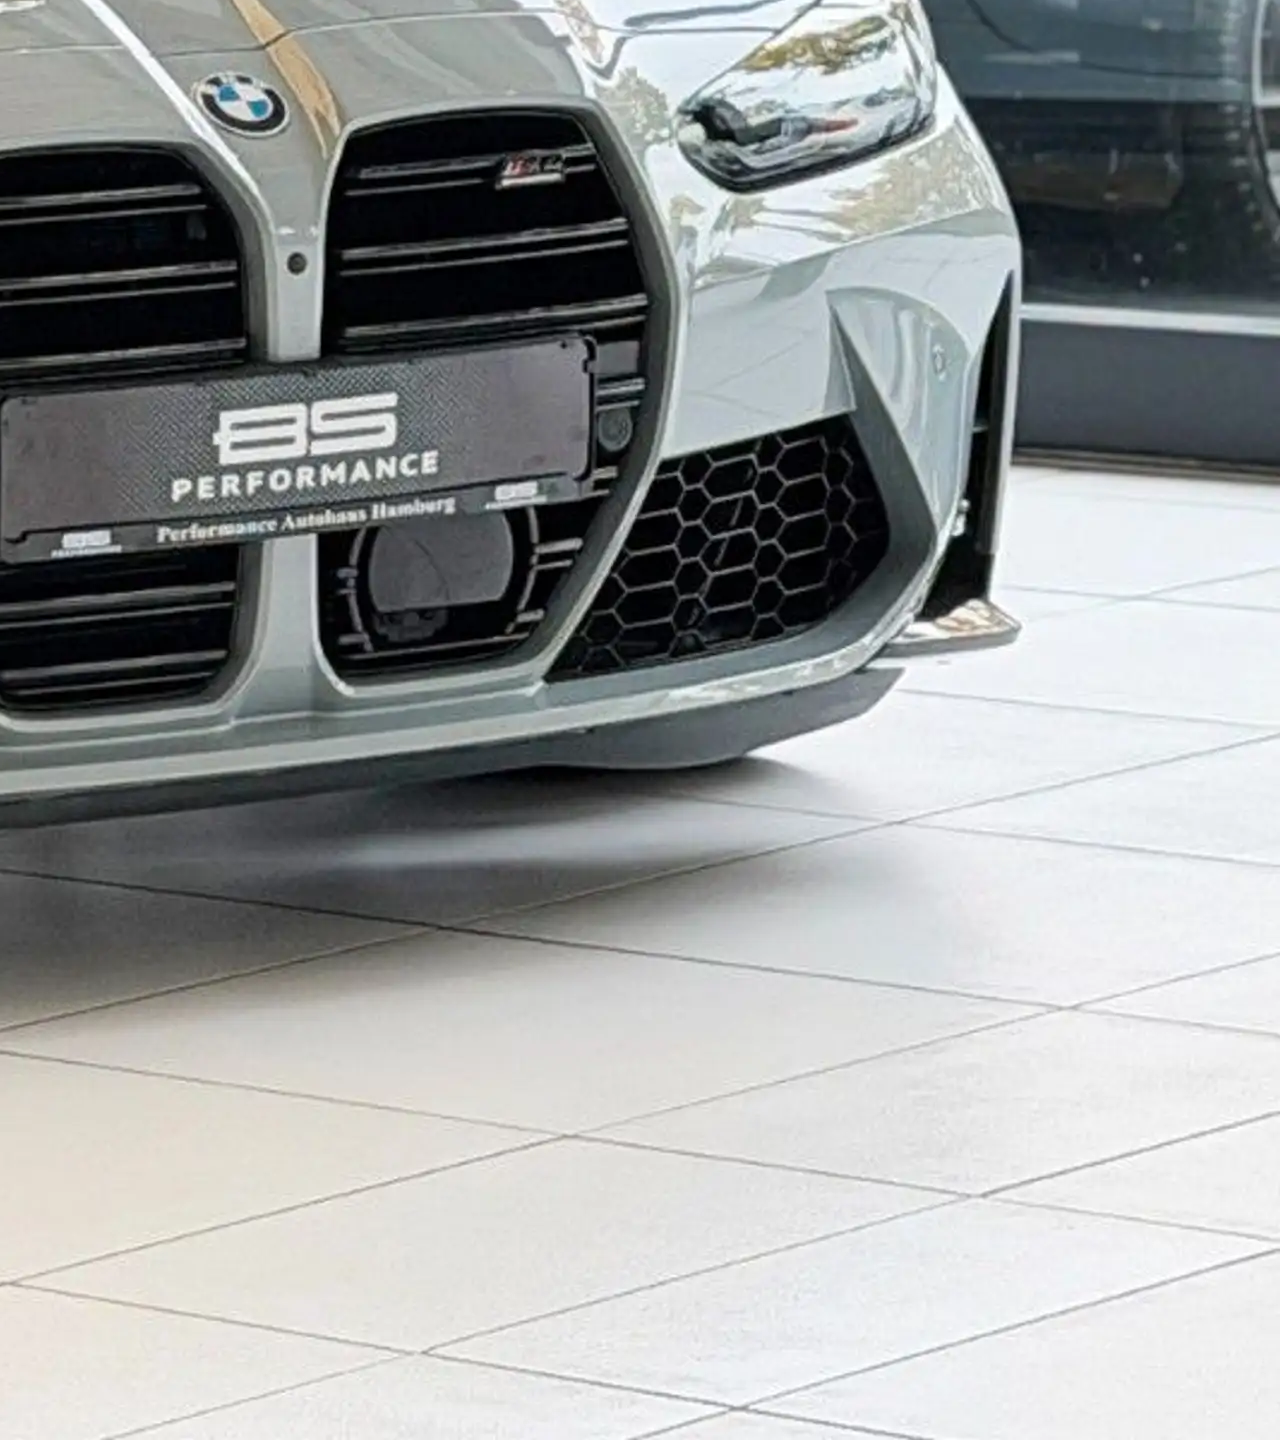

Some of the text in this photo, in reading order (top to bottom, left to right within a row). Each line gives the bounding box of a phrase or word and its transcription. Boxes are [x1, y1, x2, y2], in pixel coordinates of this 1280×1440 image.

[171, 450, 439, 503] PERFORMANCE
[156, 496, 456, 543] Performance Autohaus Hamburg
